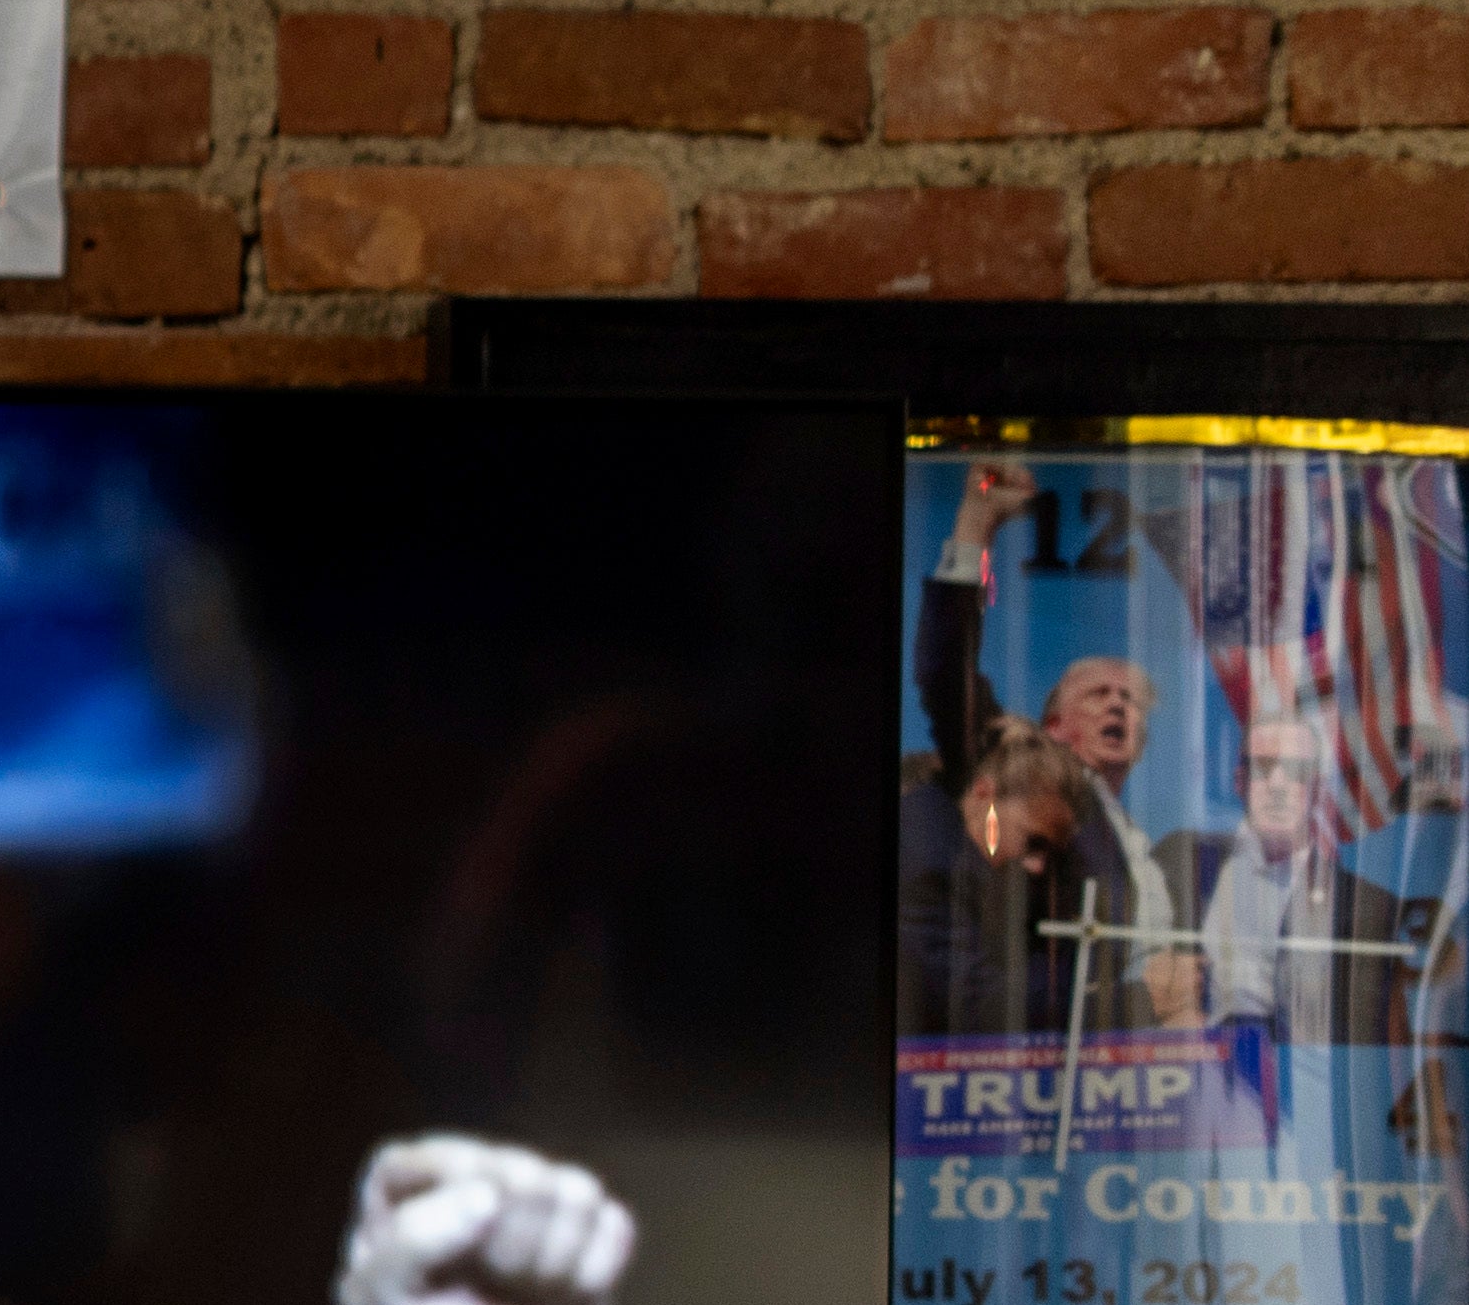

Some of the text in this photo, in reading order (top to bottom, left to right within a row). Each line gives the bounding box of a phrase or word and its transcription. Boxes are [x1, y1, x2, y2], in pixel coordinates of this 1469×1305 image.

[1024, 489, 1140, 577] 12
[911, 1065, 1193, 1117] TRUMP
[929, 1155, 1060, 1221] for
[1083, 1163, 1443, 1240] Country
[1140, 1259, 1303, 1305] 2024
